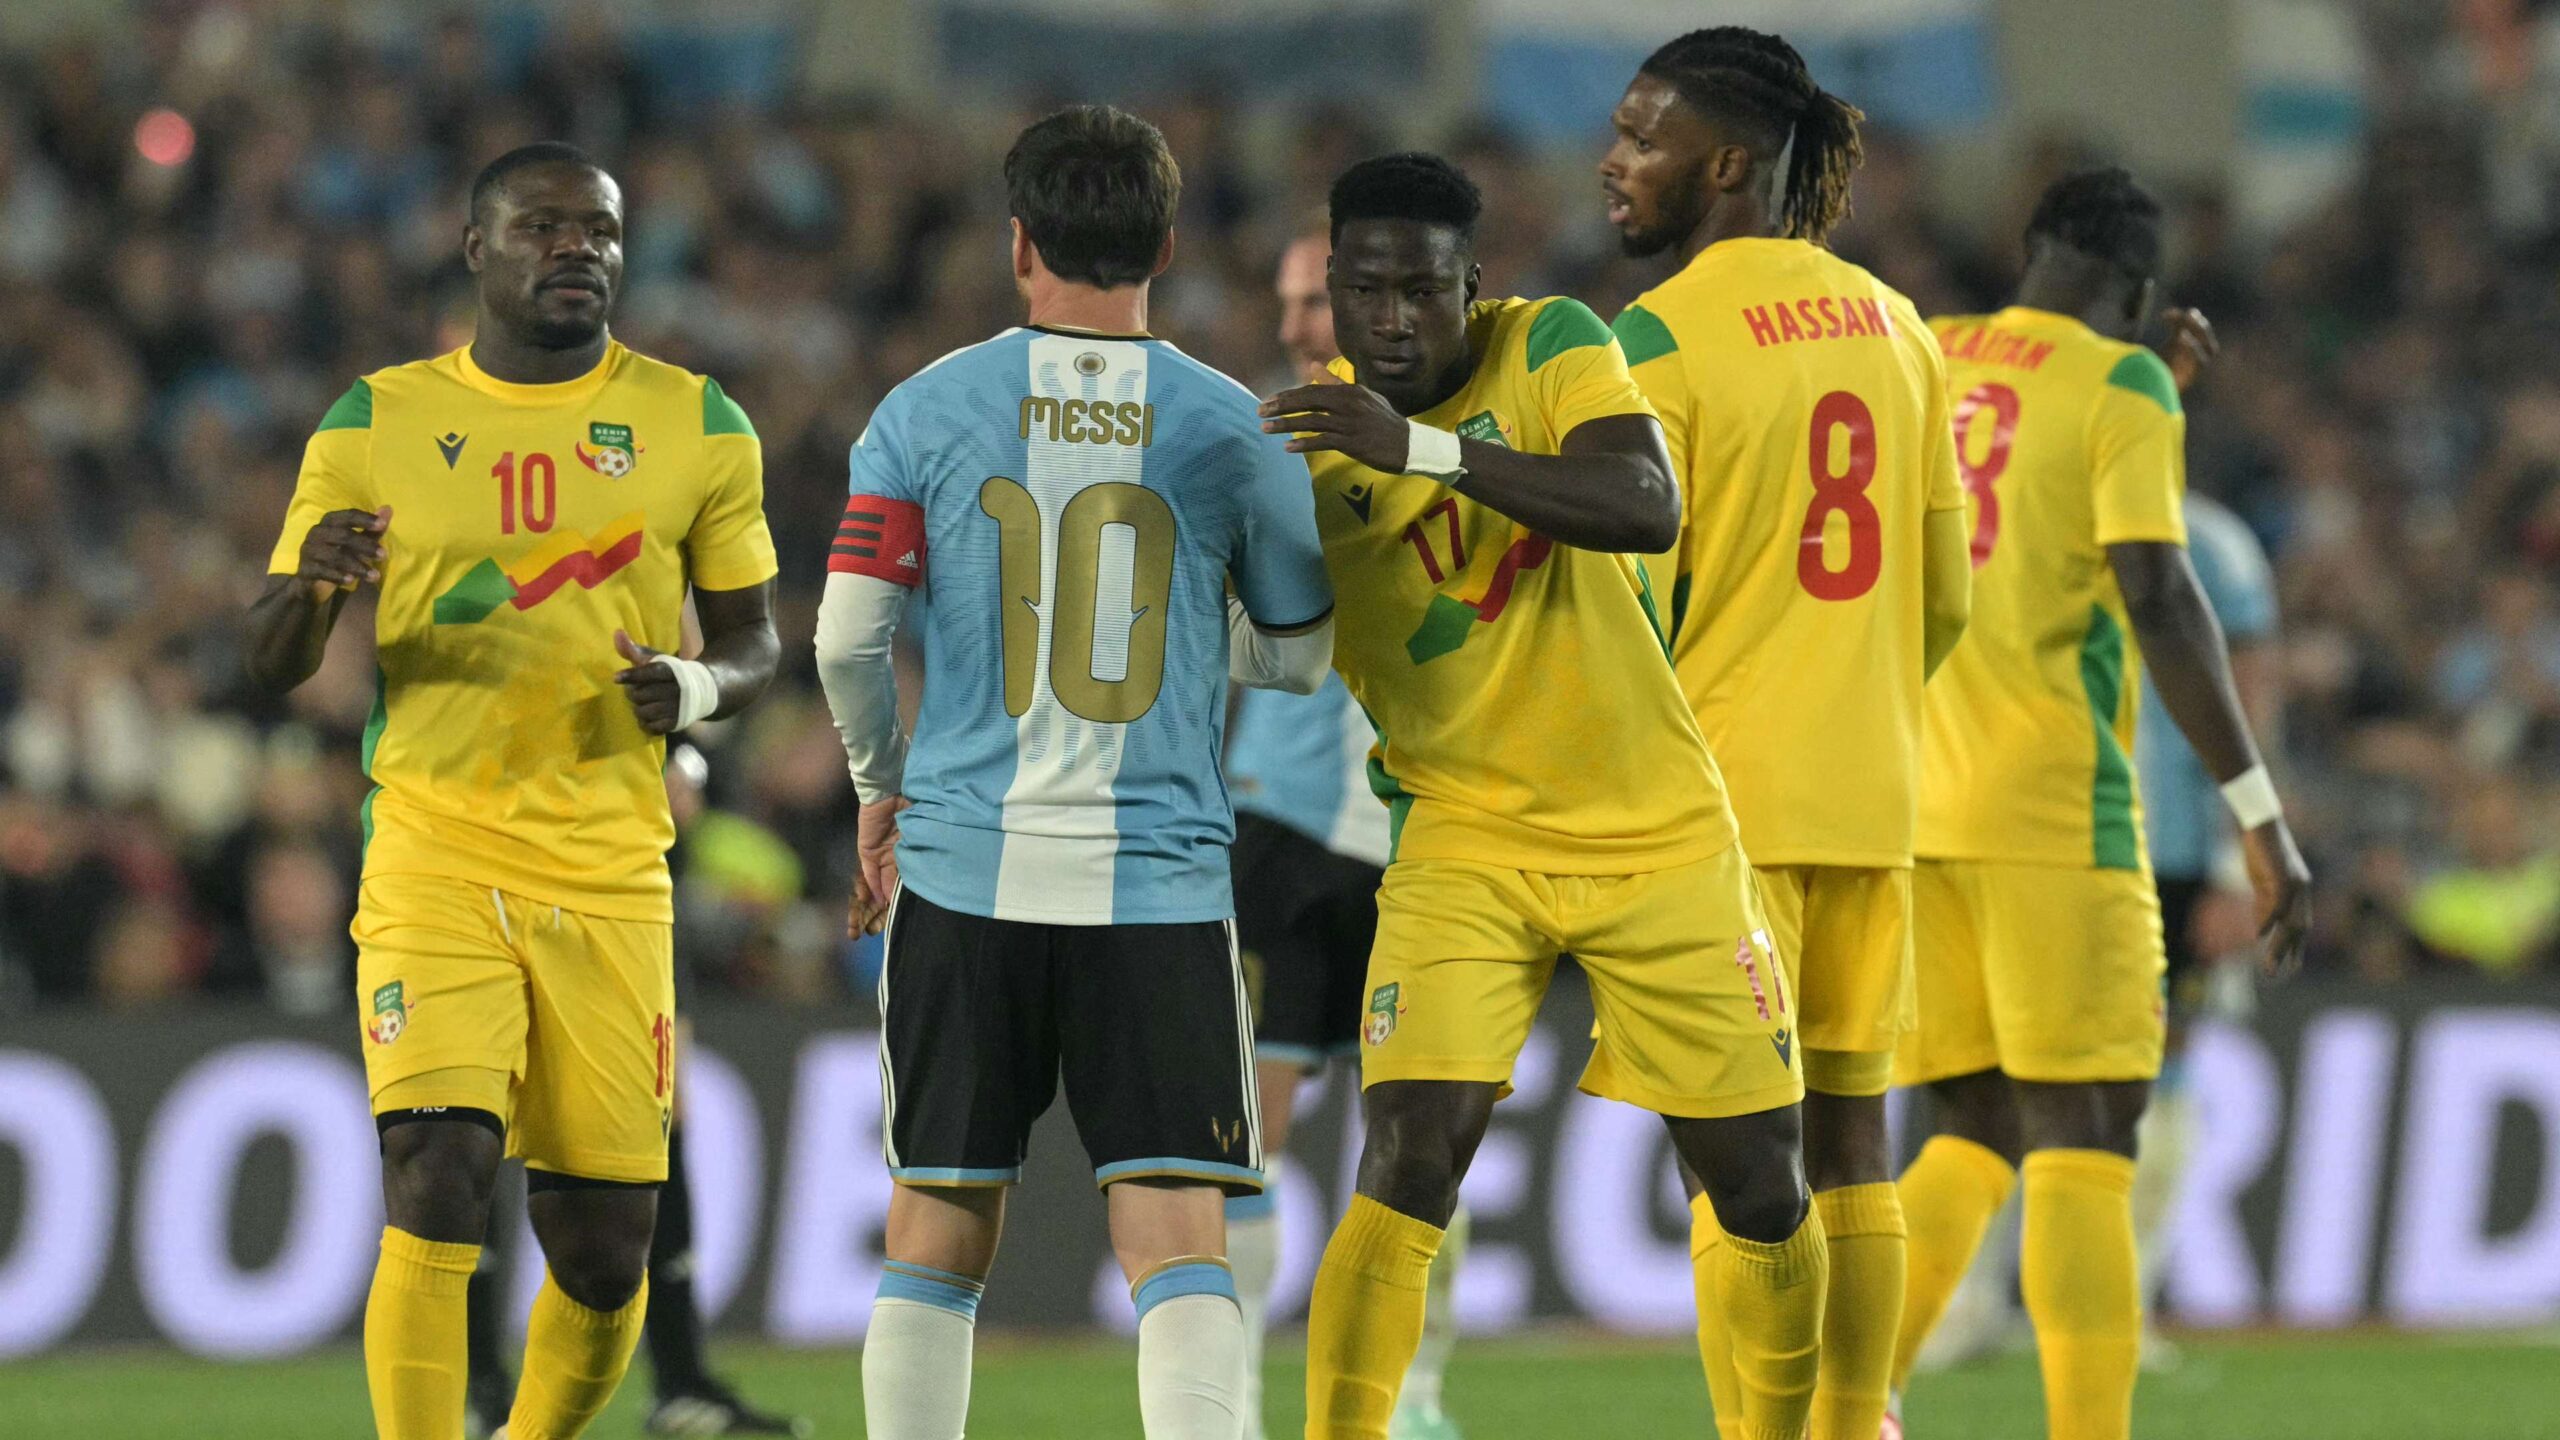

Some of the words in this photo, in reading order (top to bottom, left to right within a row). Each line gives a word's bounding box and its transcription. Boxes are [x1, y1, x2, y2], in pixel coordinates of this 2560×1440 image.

[1019, 396, 1154, 447] MESSI
[491, 451, 556, 534] 10
[1797, 390, 1881, 601] 8
[1402, 497, 1466, 584] 17
[979, 476, 1176, 723] 10
